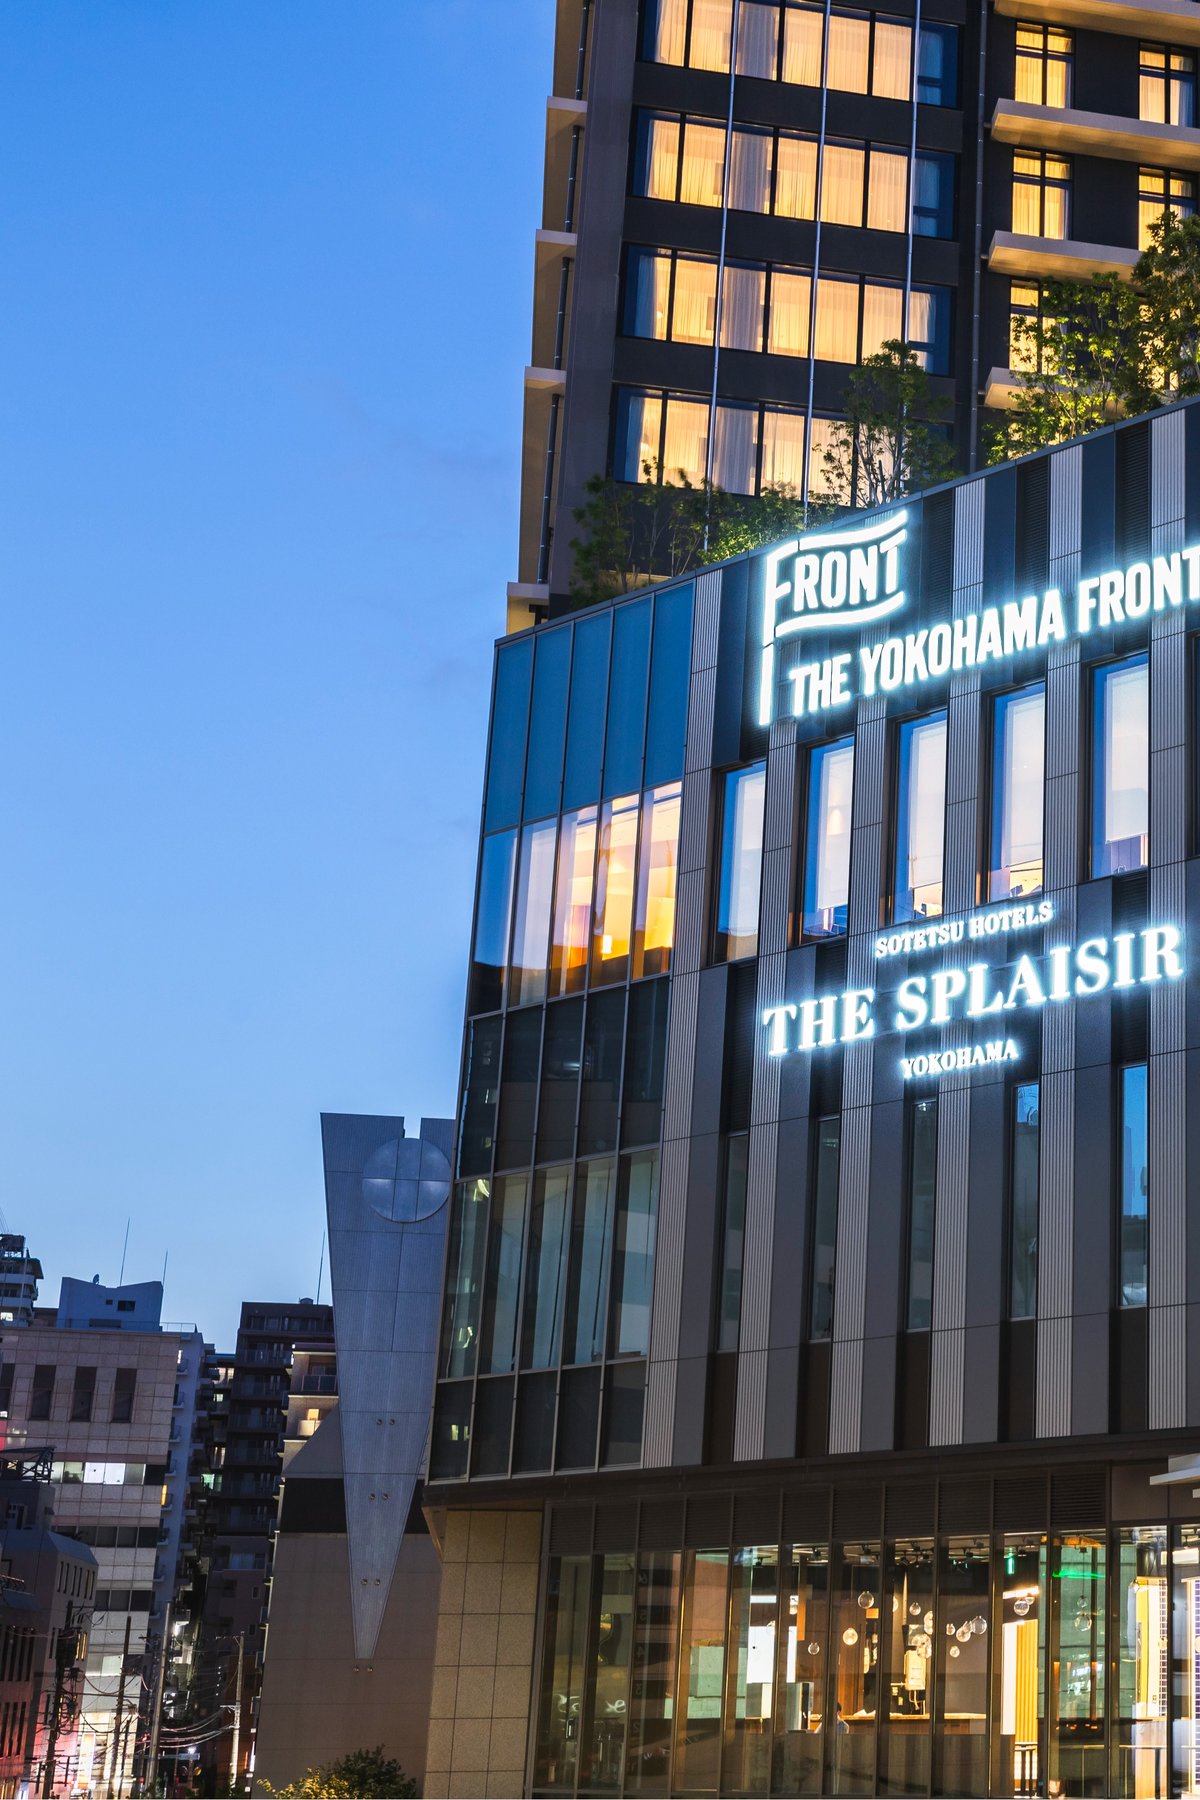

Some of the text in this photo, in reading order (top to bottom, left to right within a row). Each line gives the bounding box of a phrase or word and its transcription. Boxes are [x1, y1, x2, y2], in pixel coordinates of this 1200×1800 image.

[759, 509, 907, 726] FRONT
[789, 652, 851, 716] THE
[859, 588, 1066, 696] YOKOHAMA
[762, 925, 1185, 1057] THE SPLAISIR
[874, 901, 1054, 958] SOTETSU HOTELS
[901, 1038, 1019, 1079] YOKOHAMA
